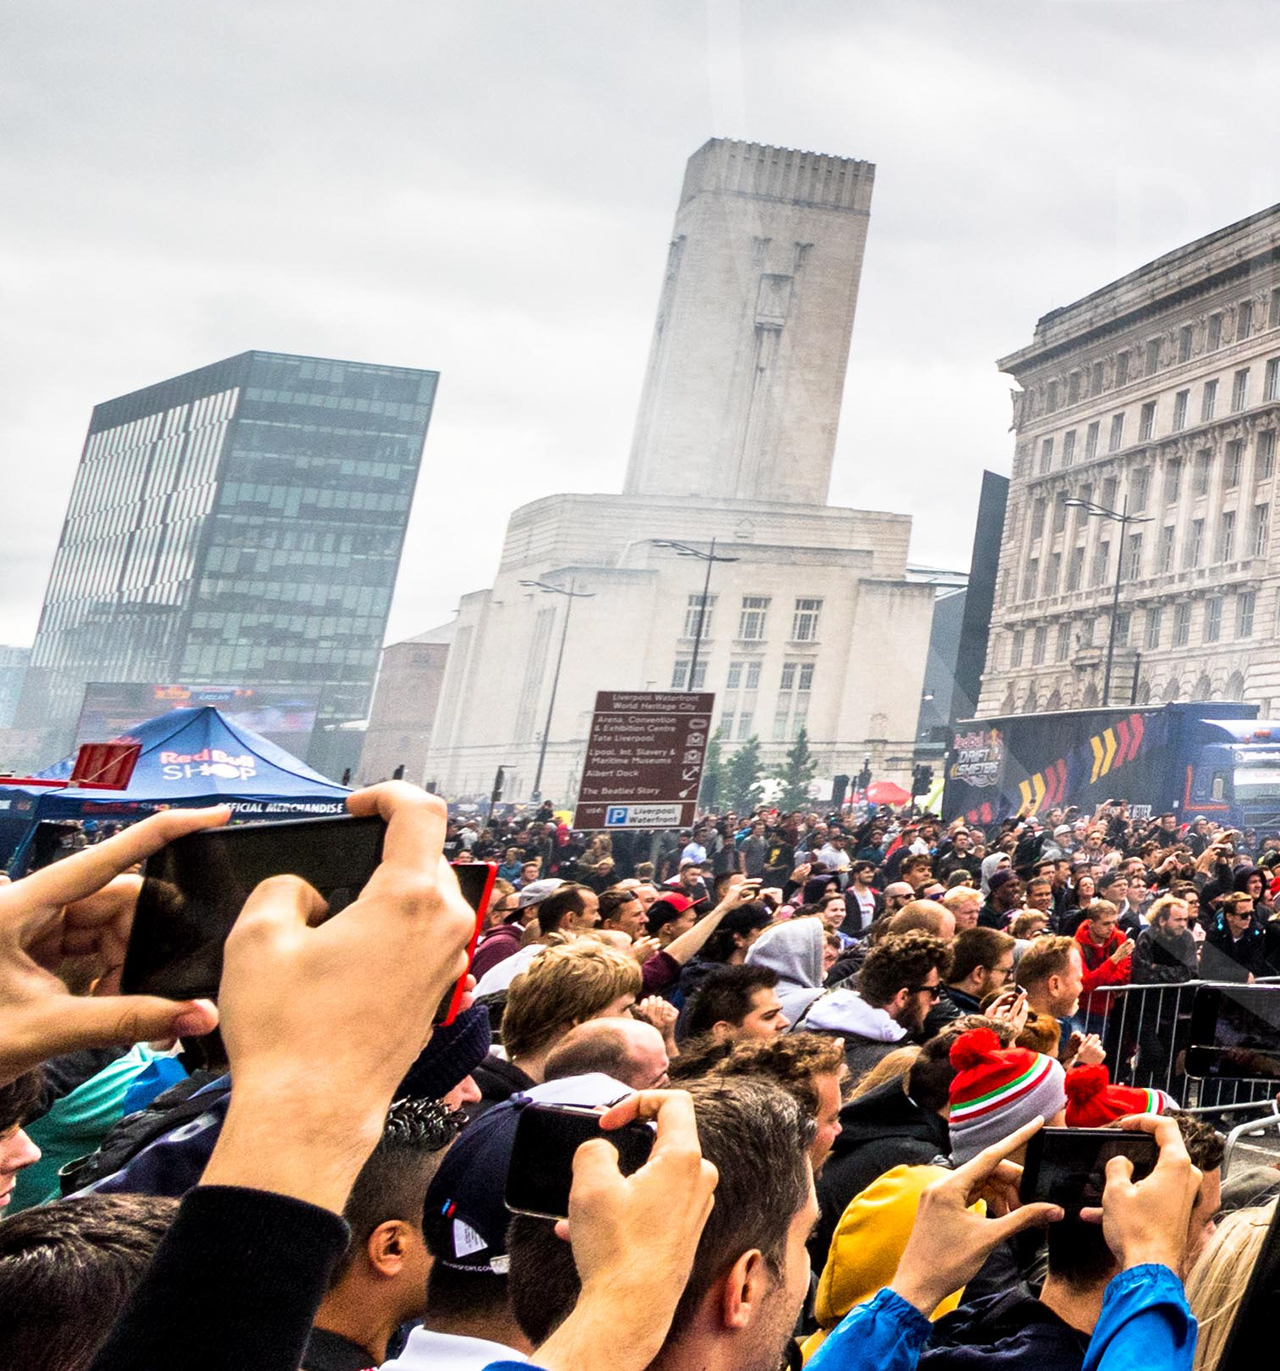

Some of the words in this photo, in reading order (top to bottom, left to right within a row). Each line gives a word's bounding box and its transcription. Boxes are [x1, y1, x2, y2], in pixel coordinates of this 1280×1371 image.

[612, 694, 652, 702] Liverpool
[654, 694, 700, 702] Waterfront
[641, 703, 676, 711] Heritage
[680, 703, 696, 711] City
[603, 724, 645, 732] Exhibition
[593, 734, 612, 742] Tate
[614, 734, 655, 742] Liverpool
[637, 749, 667, 757] Slavery
[637, 788, 660, 796] Story
[265, 802, 344, 814] MERCHANDISE
[634, 807, 675, 816] Liverpool
[612, 809, 626, 823] P
[629, 816, 678, 824] Waterfront
